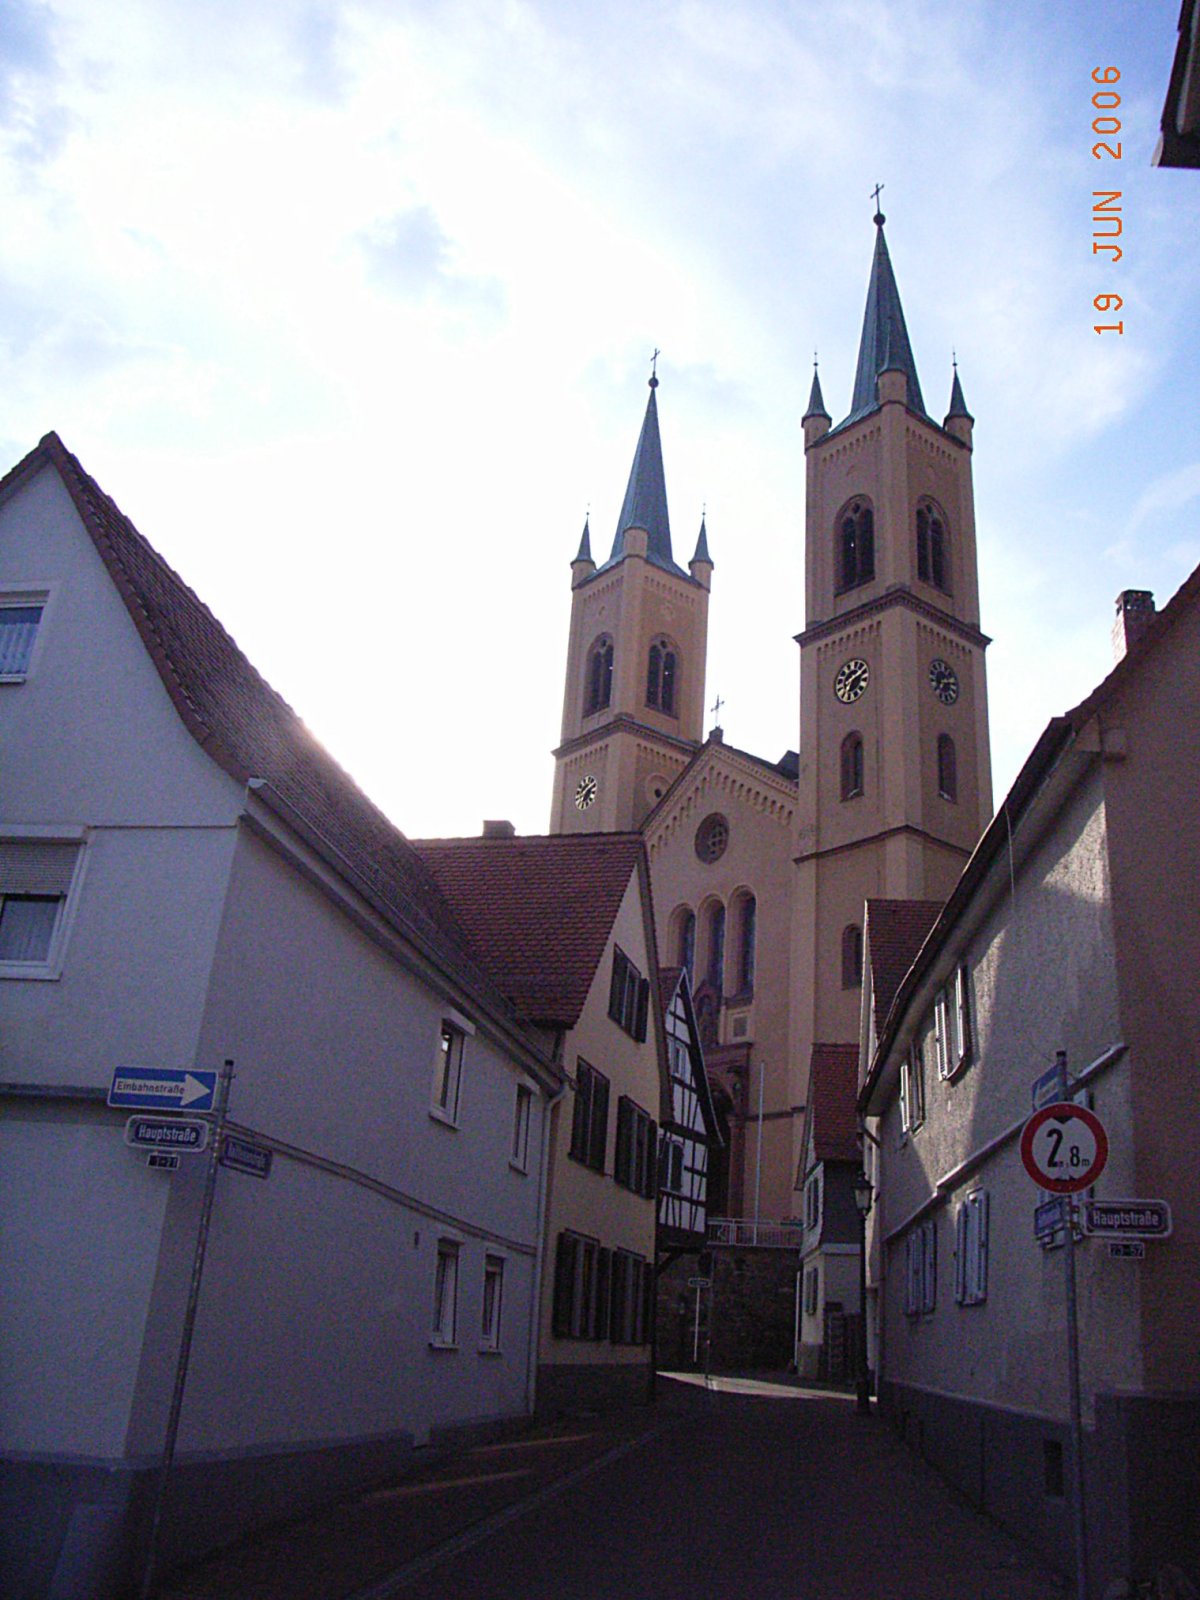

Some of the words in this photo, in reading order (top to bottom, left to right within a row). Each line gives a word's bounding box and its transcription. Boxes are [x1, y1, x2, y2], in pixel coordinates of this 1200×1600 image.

[116, 1080, 185, 1095] Einbahnstraße
[138, 1124, 196, 1142] Hauptstraße
[1092, 1211, 1159, 1228] Hauptstraße
